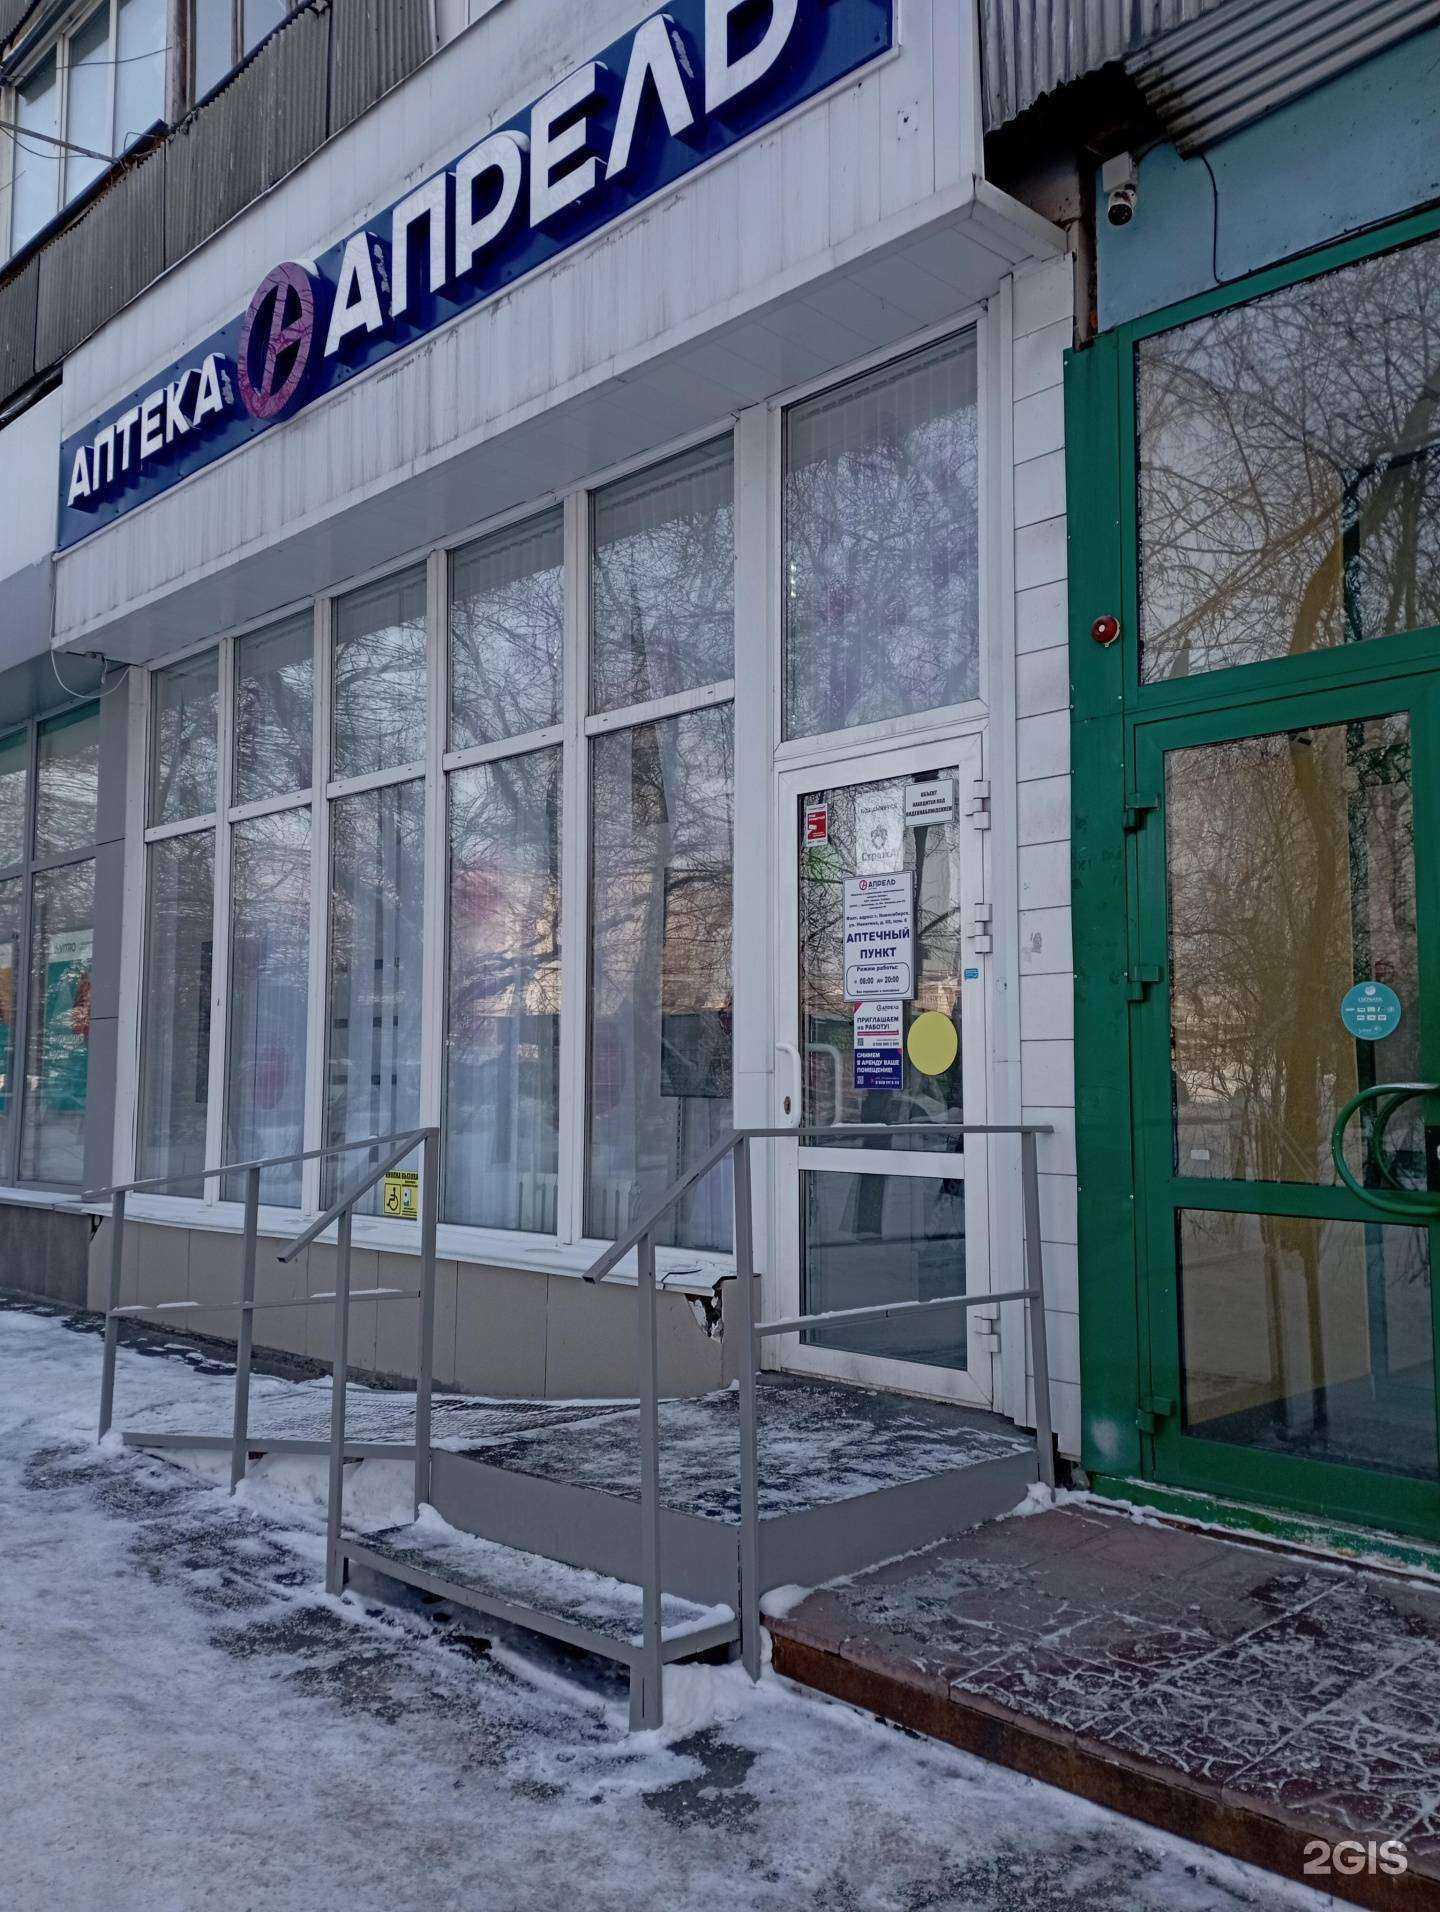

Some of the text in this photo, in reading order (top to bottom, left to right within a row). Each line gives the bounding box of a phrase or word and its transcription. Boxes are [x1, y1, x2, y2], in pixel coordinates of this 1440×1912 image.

[67, 0, 798, 506] АПТЕКА АПРЕЛЬ
[846, 927, 910, 943] АПТЕЧНЫЙ
[860, 947, 896, 959] ПУНКТ
